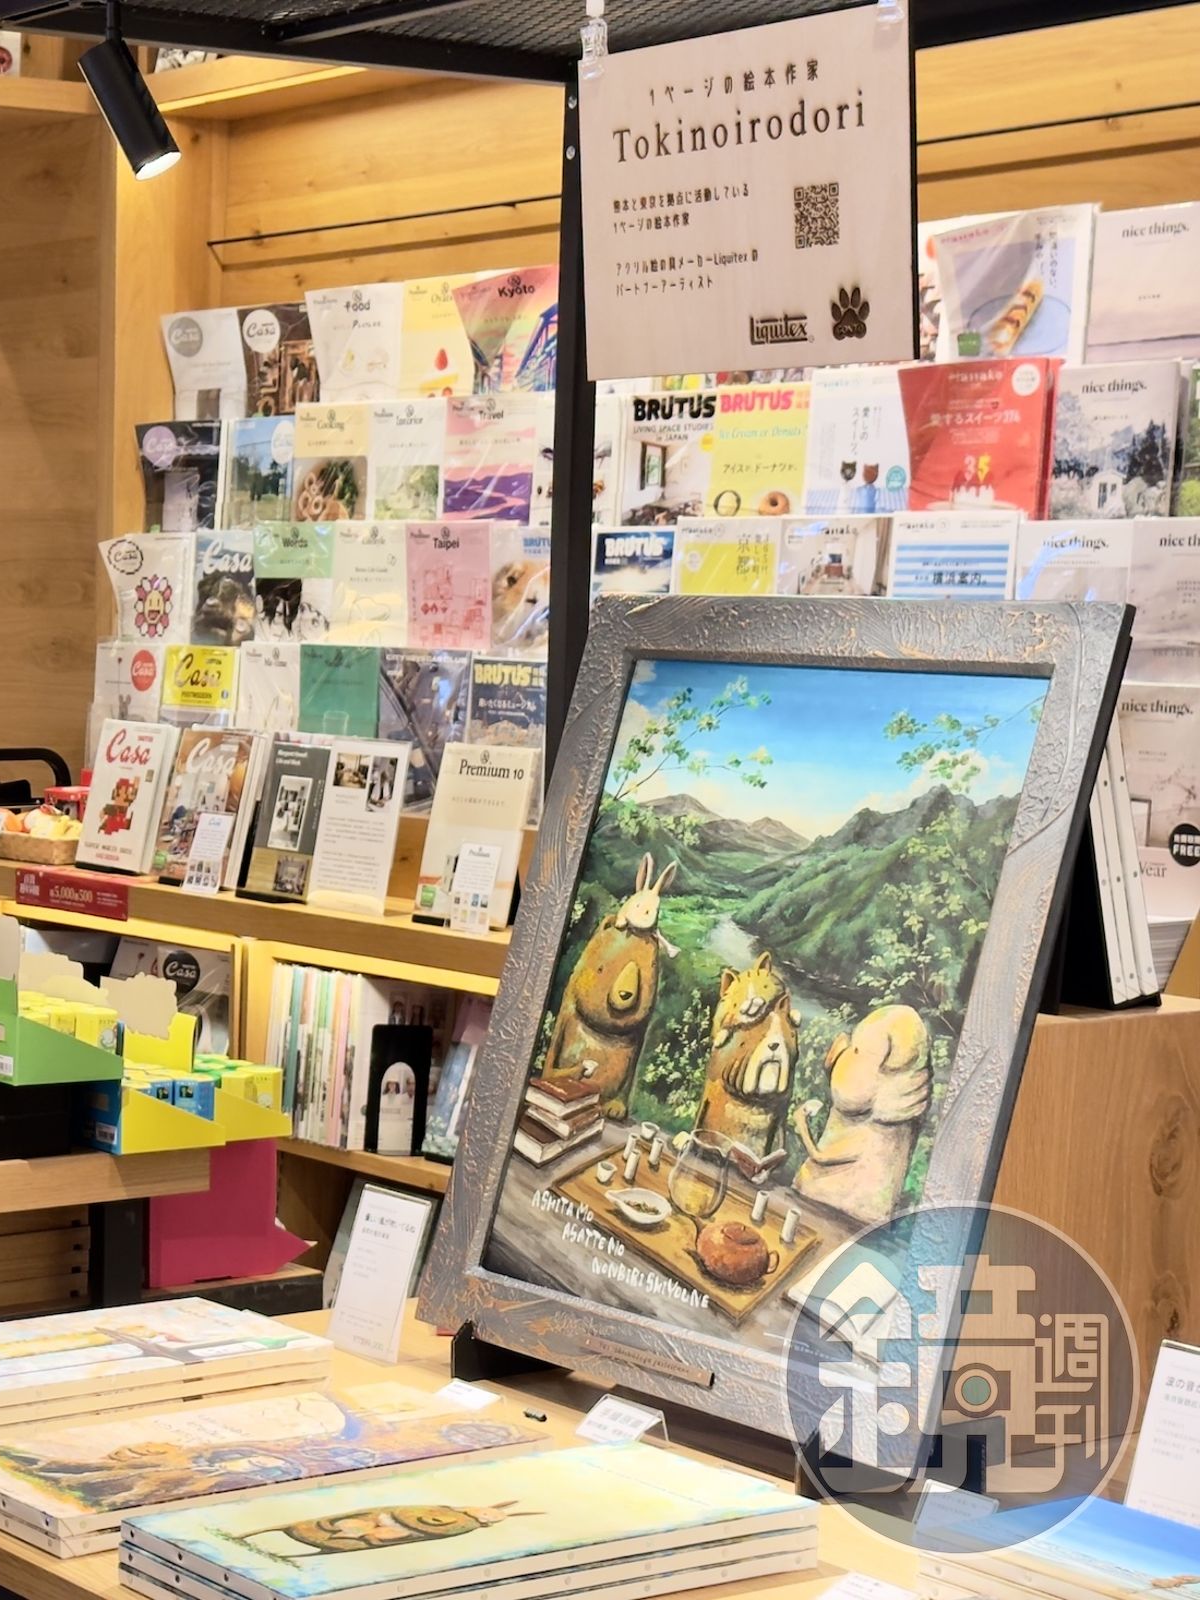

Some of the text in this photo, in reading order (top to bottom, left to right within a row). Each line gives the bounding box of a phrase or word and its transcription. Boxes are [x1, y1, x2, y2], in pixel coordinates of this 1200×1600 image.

[612, 89, 866, 163] Tokinoirodori
[498, 284, 536, 298] Kyoto
[246, 322, 277, 338] Casa
[749, 314, 809, 346] Liquitex
[633, 394, 717, 421] BRUTUS
[720, 389, 795, 414] BRUTUS
[316, 418, 346, 431] Cooking
[433, 537, 460, 551] Taipei
[523, 537, 551, 548] BRUTU
[605, 537, 666, 558] BRUTUS
[203, 538, 252, 575] Casa
[132, 661, 155, 677] Casa
[175, 653, 222, 688] Casa
[474, 663, 533, 687] BRUTUS
[1121, 699, 1194, 716] nice things.
[105, 728, 152, 765] Casa
[186, 737, 237, 775] Casa
[459, 759, 525, 780] Premium 10
[165, 961, 197, 979] Casa
[531, 1189, 574, 1217] ASHITA
[562, 1222, 606, 1250] ASATTE
